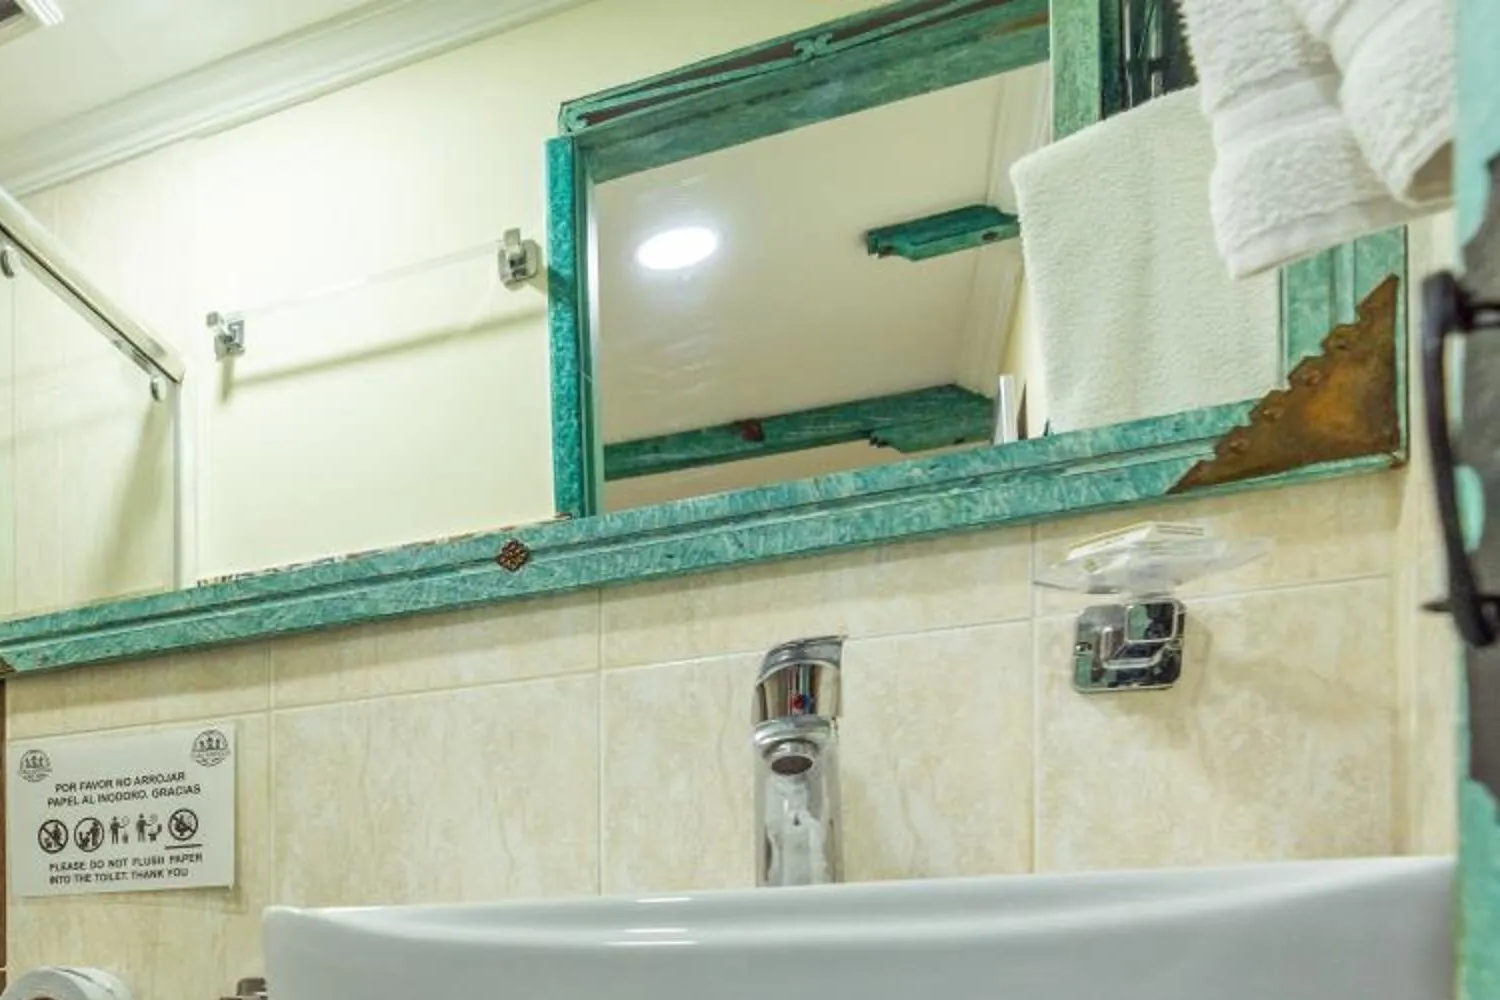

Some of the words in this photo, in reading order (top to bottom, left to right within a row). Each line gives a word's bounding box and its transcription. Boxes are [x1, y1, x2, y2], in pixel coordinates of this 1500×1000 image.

[55, 782, 77, 793] POR
[79, 778, 113, 791] FAVOR
[115, 777, 132, 788] NO
[134, 771, 185, 786] ARROJAR
[47, 796, 79, 808] PAPEL
[81, 794, 95, 805] AL
[151, 783, 201, 799] GRACIAS
[49, 861, 85, 873] PLEASE
[89, 859, 105, 870] DO
[107, 857, 129, 868] NOT
[131, 855, 165, 867] FLUSH
[169, 852, 203, 865] PAPER
[49, 875, 71, 885] INTO
[74, 872, 92, 883] THE
[131, 869, 165, 880] THANK
[167, 867, 189, 878] YOU
